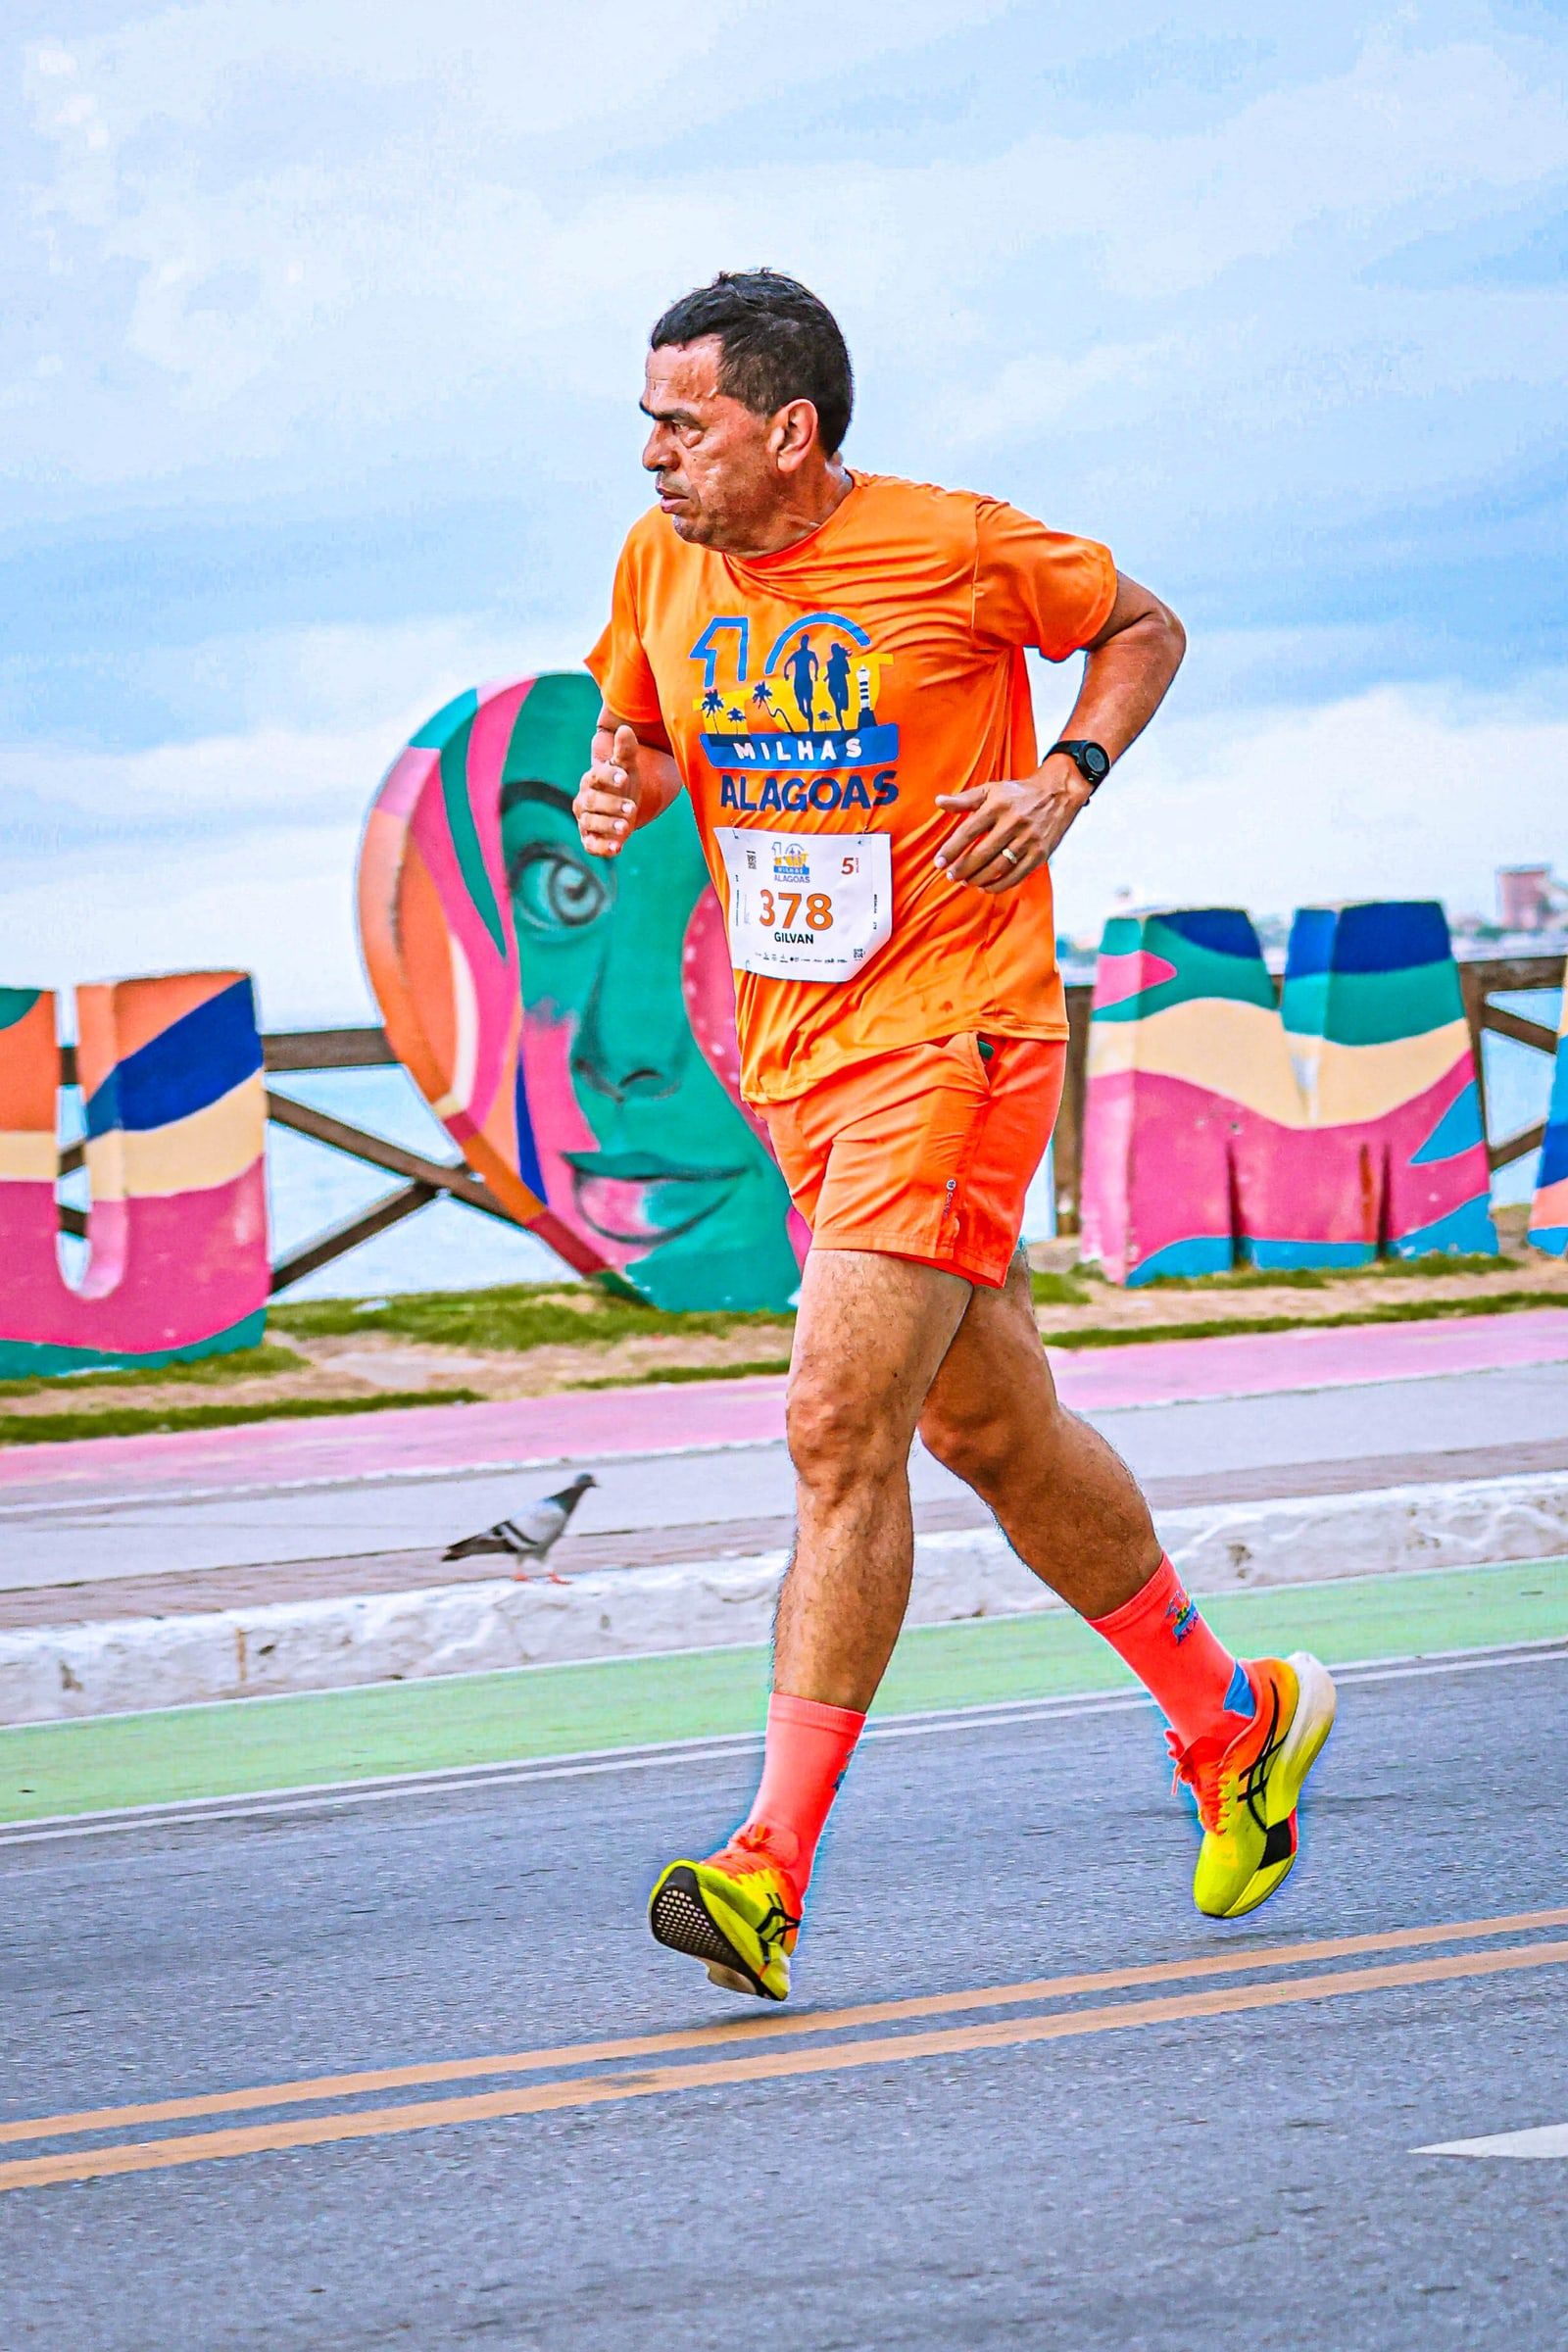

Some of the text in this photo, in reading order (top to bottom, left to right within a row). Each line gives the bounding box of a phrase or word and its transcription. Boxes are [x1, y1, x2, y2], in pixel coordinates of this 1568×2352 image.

[733, 737, 862, 761] MILHAS
[720, 769, 900, 812] ALAGOAS
[841, 857, 855, 875] 5
[773, 874, 810, 883] ALAGOAS
[759, 888, 834, 931] 378
[773, 931, 814, 945] GILVAN
